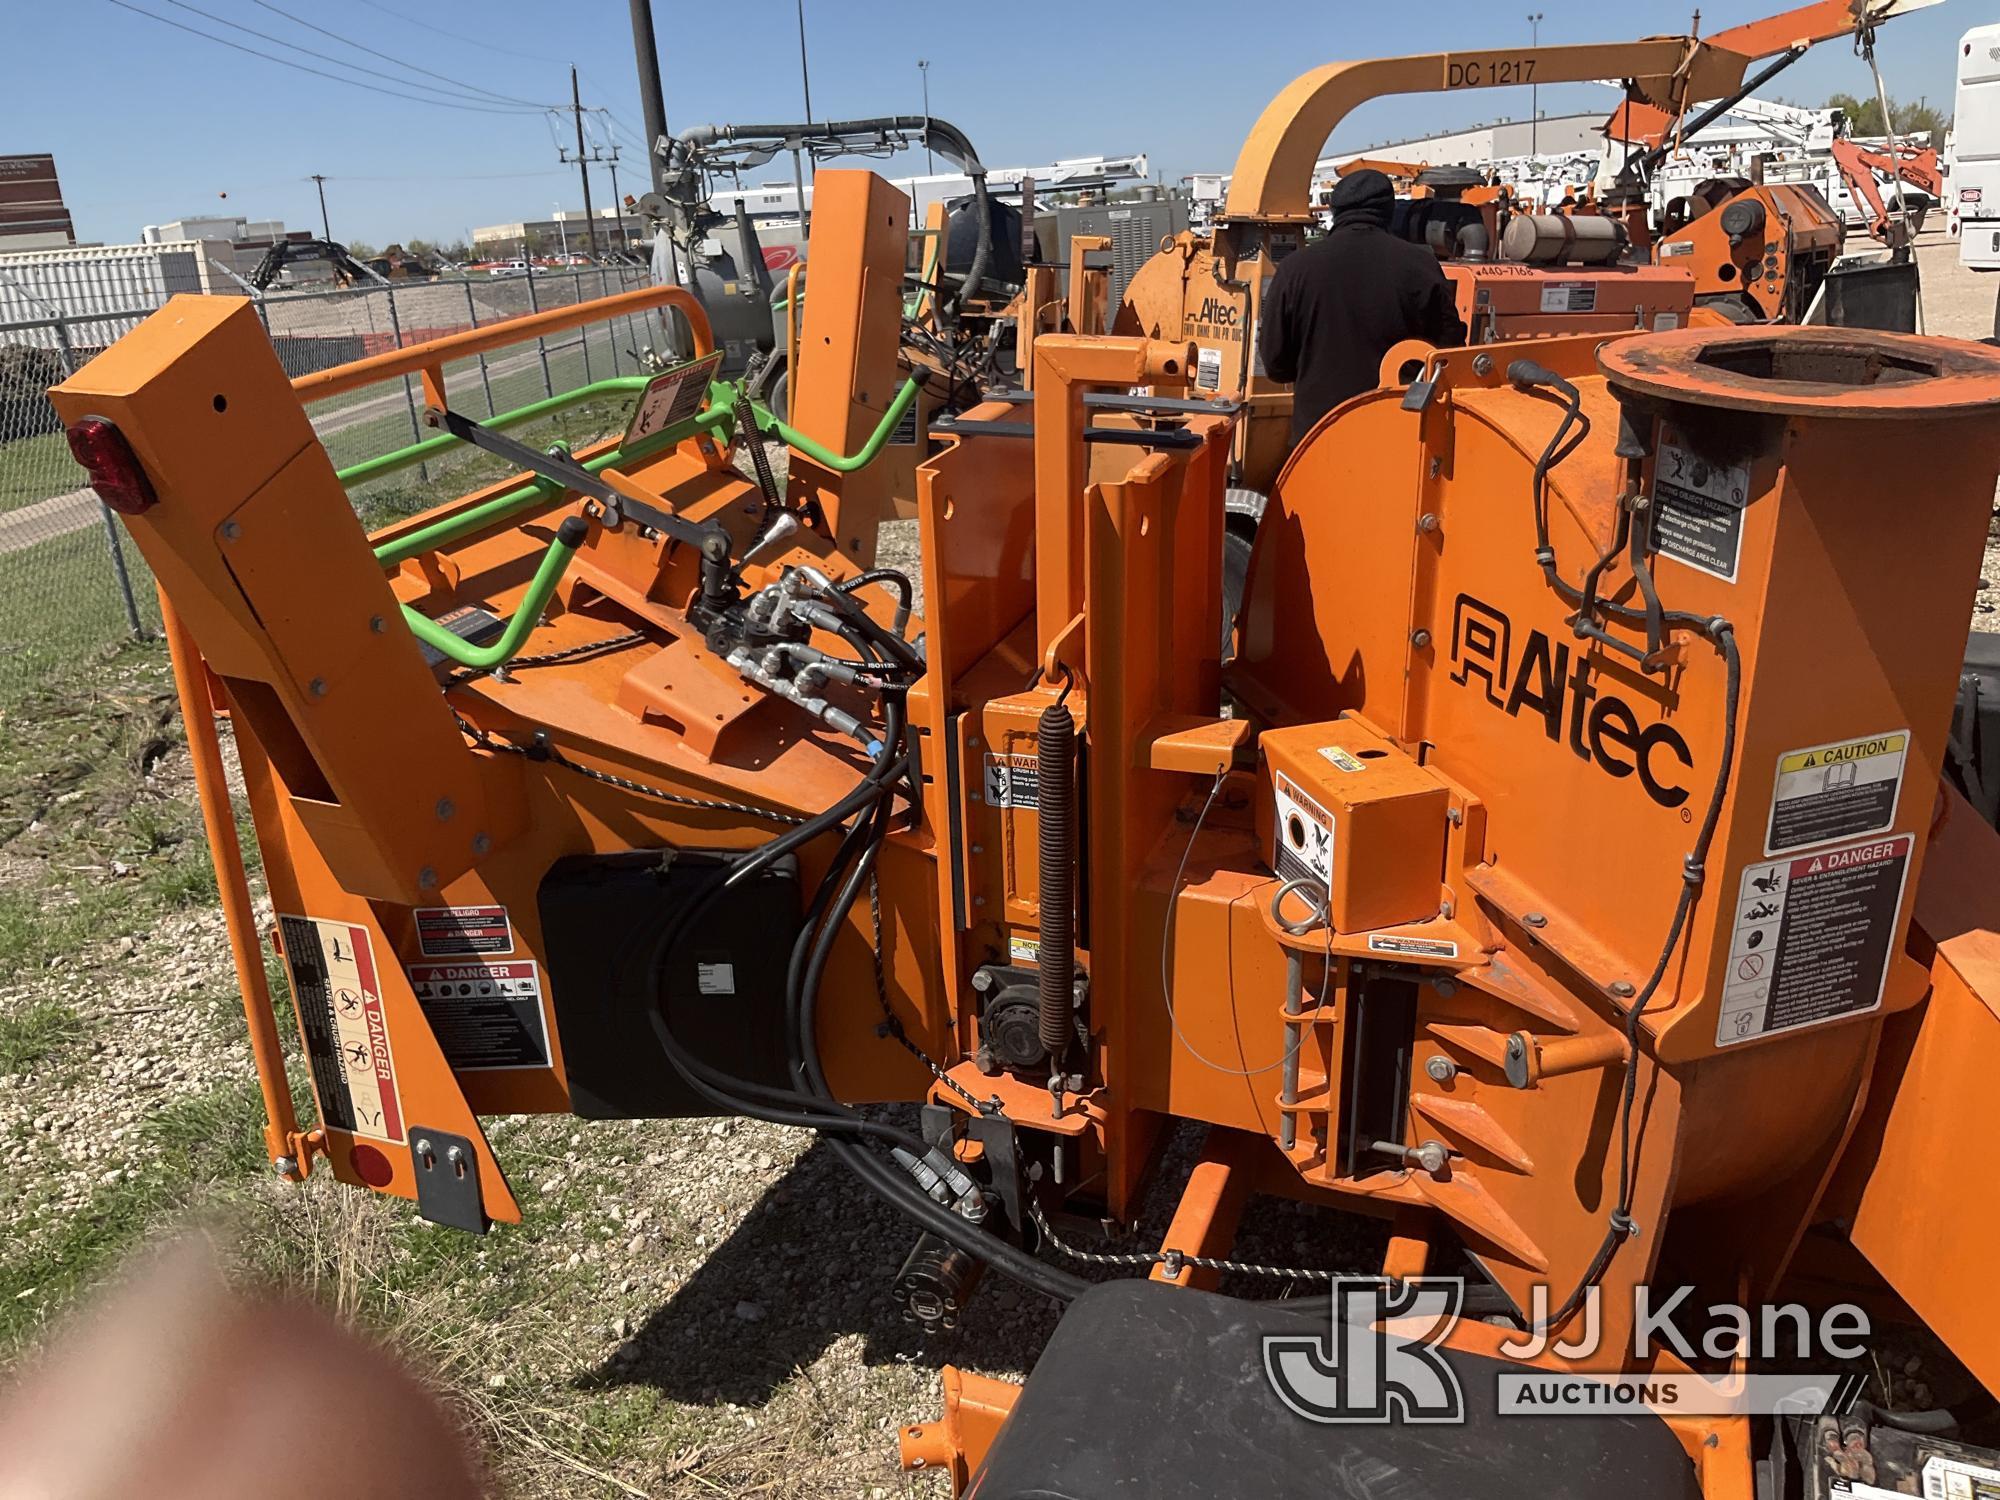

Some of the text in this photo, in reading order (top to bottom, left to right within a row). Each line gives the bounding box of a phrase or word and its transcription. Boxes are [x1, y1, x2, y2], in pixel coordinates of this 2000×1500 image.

[1449, 60, 1536, 86] DC 1217
[1901, 168, 1930, 187] FORD
[1200, 297, 1237, 326] Altec
[1505, 628, 1694, 808] Altec
[1823, 739, 1888, 763] CAUTION
[1293, 786, 1327, 825] WARNING
[1828, 842, 1894, 868] DANGER
[451, 909, 480, 917] PELIGRO
[455, 929, 483, 937] DANGER
[447, 966, 510, 980] DANGER
[323, 977, 334, 1007] SEVER
[329, 1016, 341, 1047] CRUSH
[335, 1047, 349, 1084] HAZARD
[366, 1009, 391, 1081] DANGER
